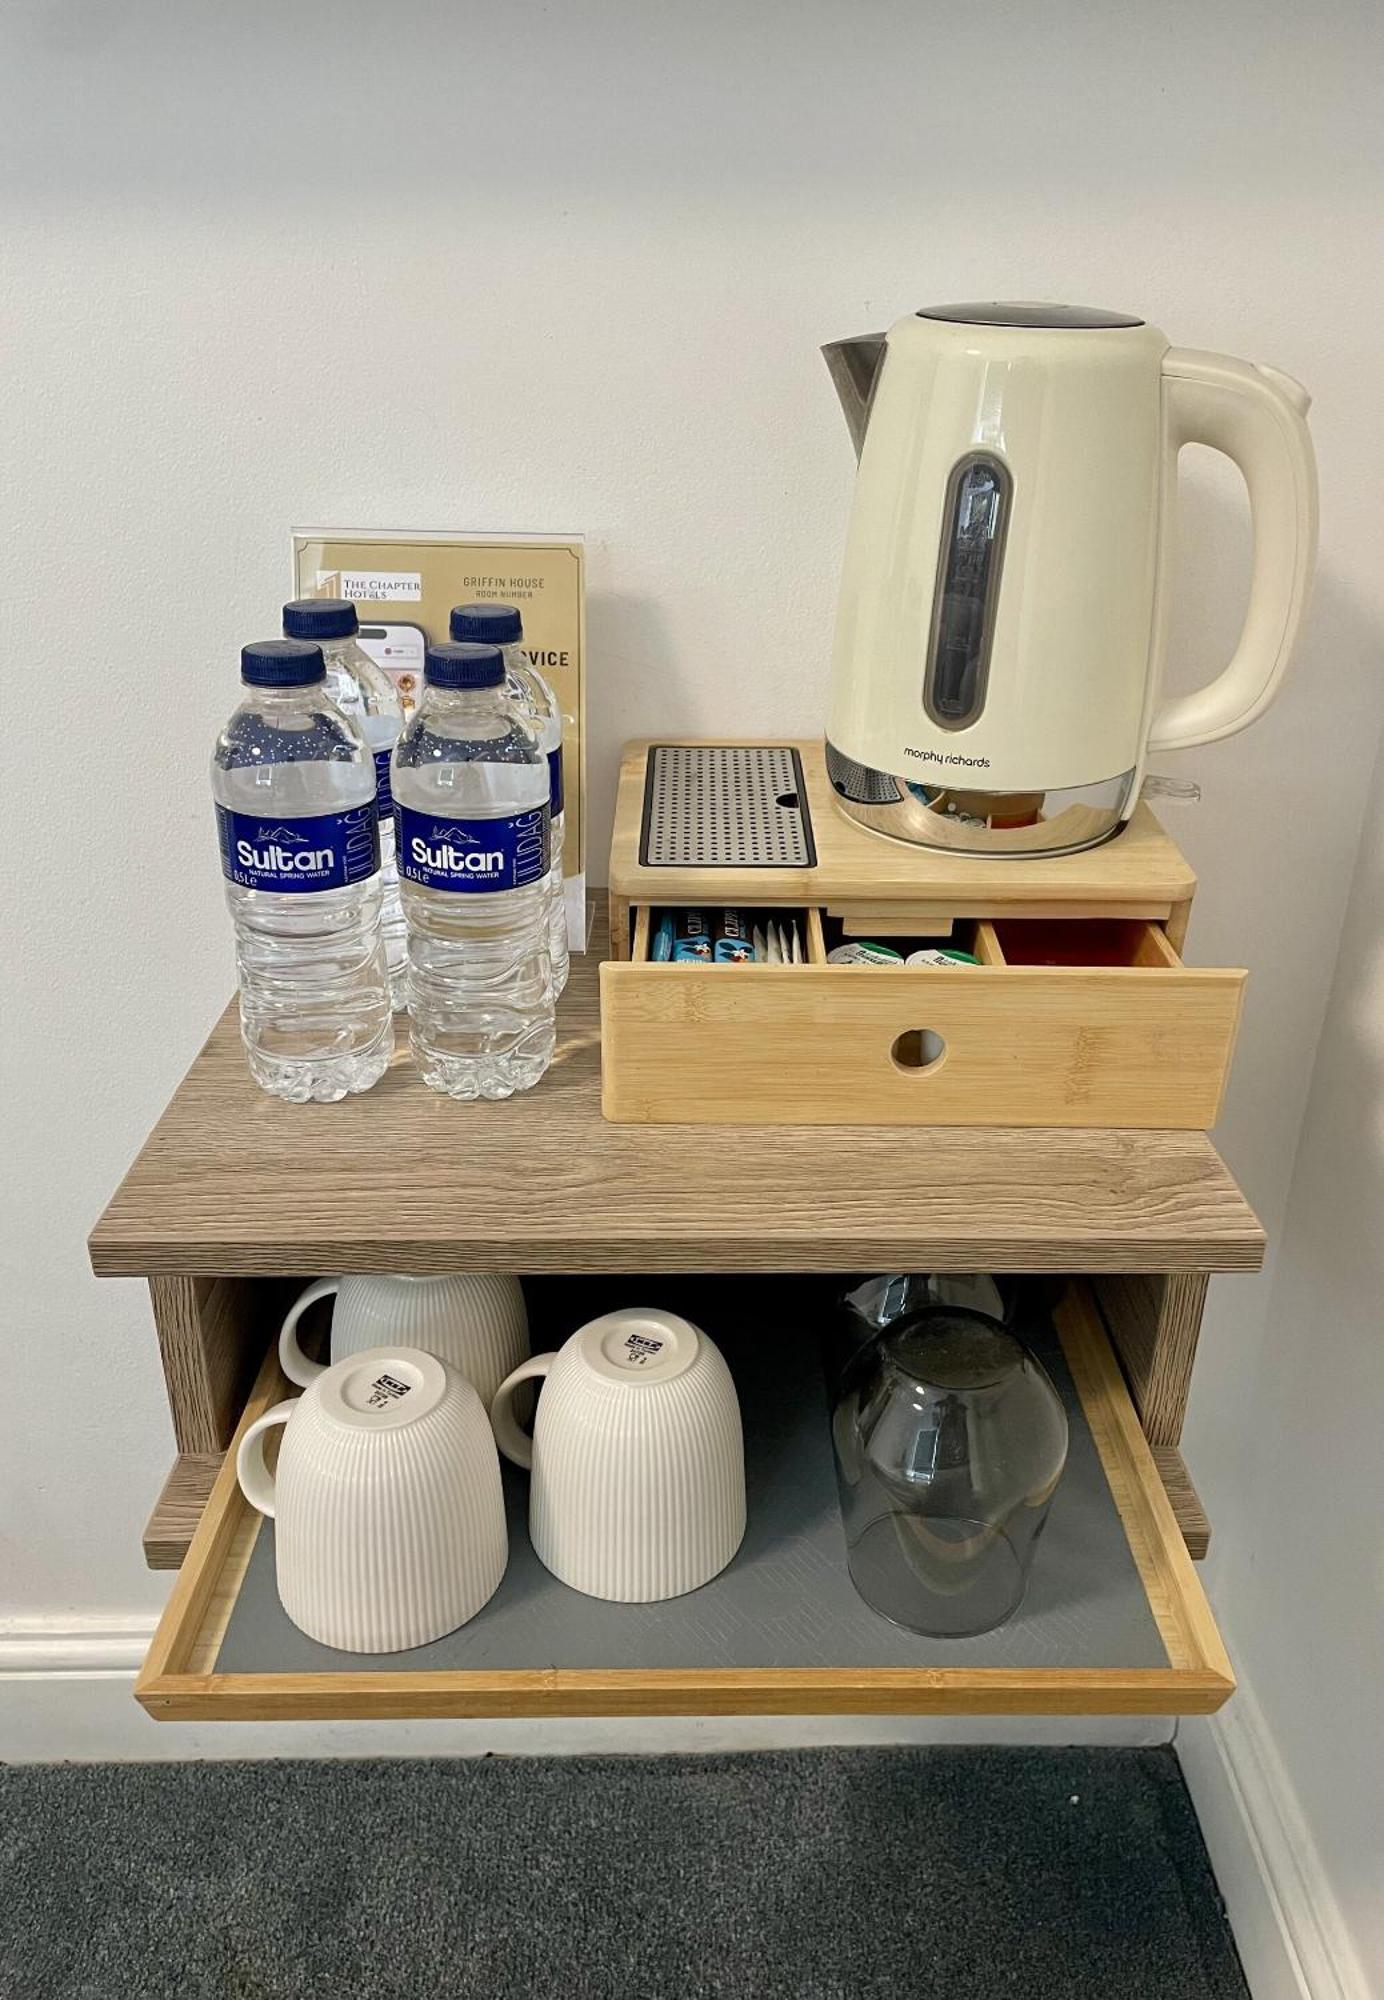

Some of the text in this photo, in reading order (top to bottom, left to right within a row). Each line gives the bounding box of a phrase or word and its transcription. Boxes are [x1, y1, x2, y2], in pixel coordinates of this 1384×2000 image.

[343, 579, 421, 591] THE CHAPTER
[463, 576, 545, 589] GRIFFIN HOUSE
[475, 589, 533, 599] ROOM NUMBER
[903, 747, 991, 768] morphy richards
[236, 840, 335, 872] Sultan
[411, 837, 505, 872] Sultan
[248, 869, 330, 880] NATURAL SPRING WATER
[450, 871, 475, 880] SPRING
[475, 871, 500, 880] WATER
